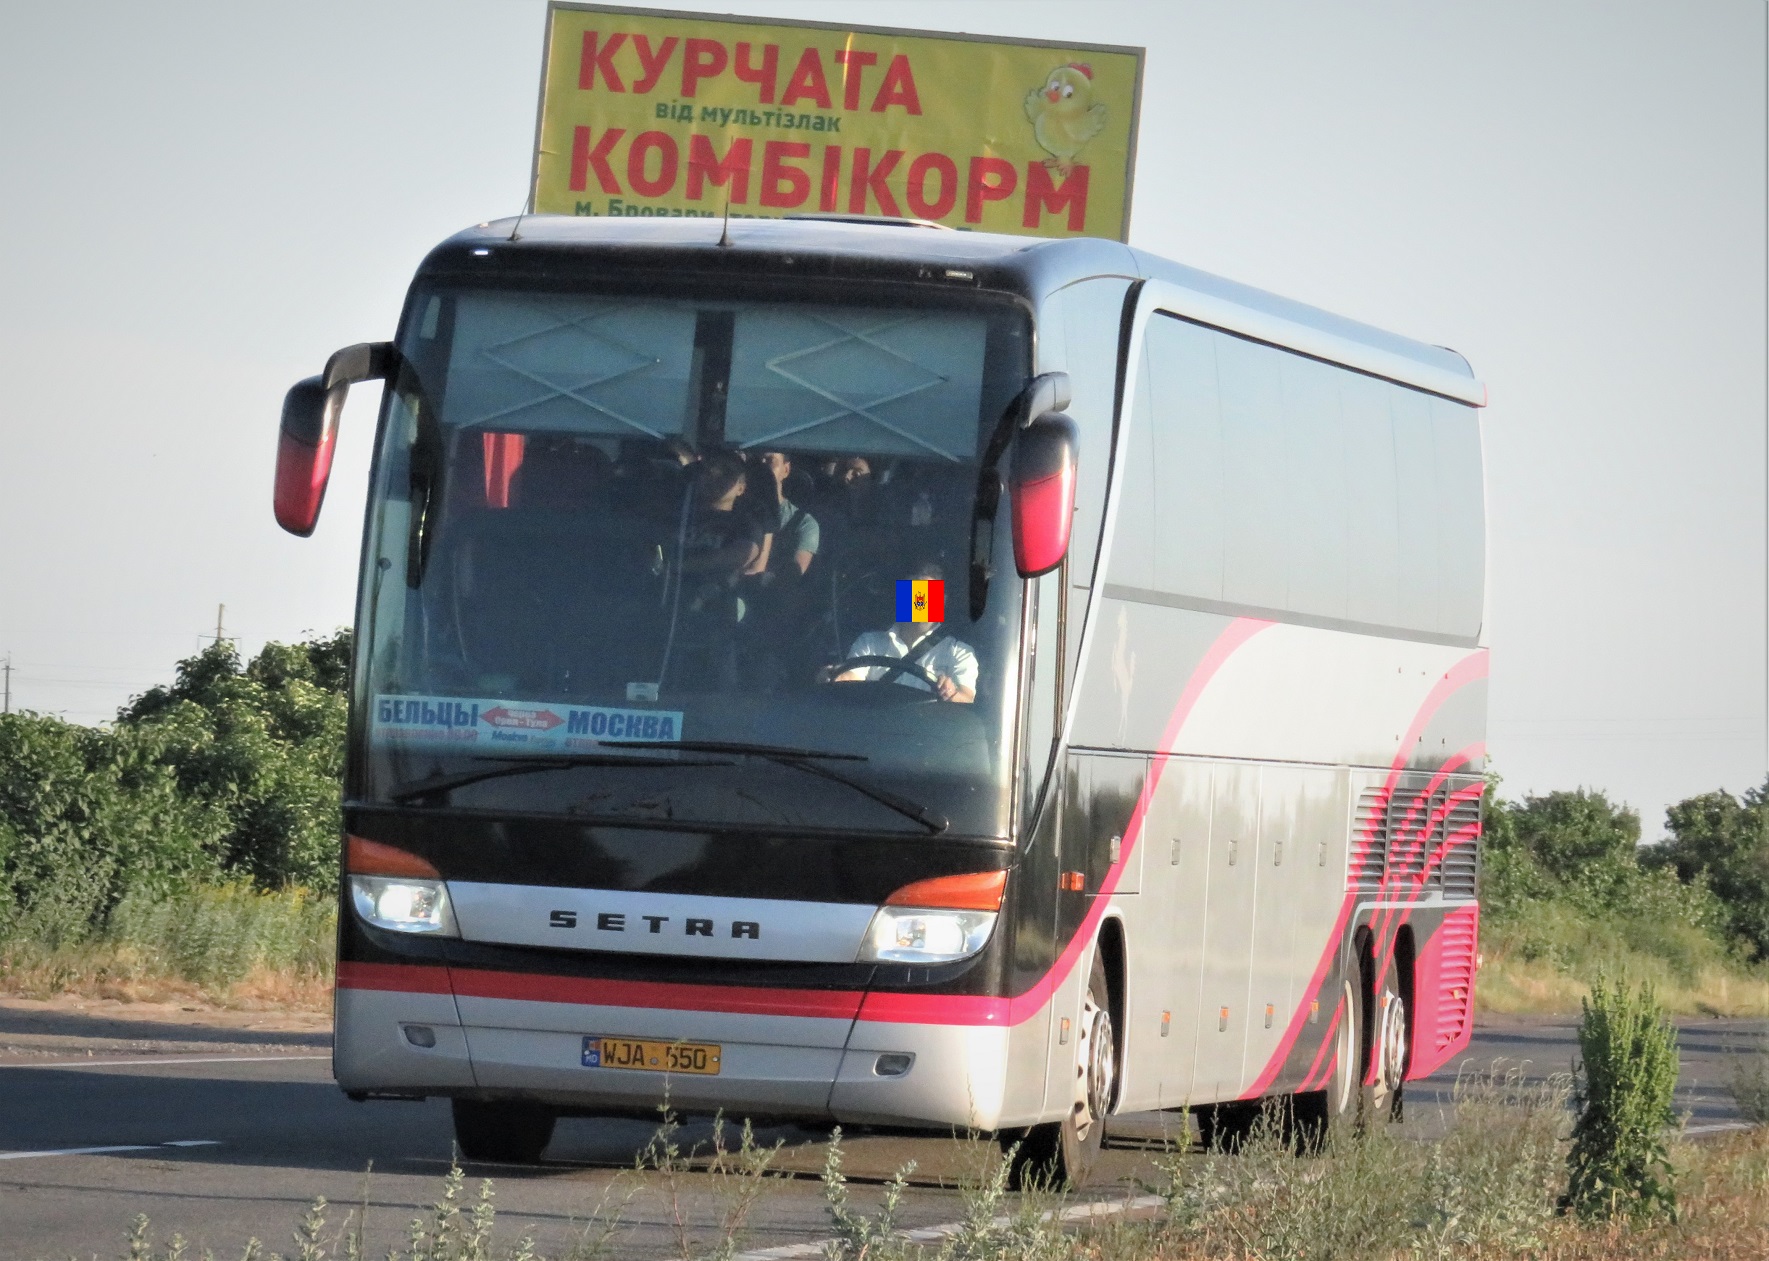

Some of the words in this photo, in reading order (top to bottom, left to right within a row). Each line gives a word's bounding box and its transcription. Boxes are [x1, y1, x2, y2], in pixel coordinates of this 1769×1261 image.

[577, 29, 923, 116] КУРЧАТА
[655, 99, 694, 123] від
[700, 106, 843, 132] мультізлак
[568, 125, 1091, 233] КОМБІКОРМ
[378, 699, 479, 728] БЕЛЬЦЫ
[567, 710, 674, 740] МОСКВА
[549, 910, 760, 940] SETRA
[585, 1053, 598, 1064] MD
[603, 1042, 645, 1067] WJA
[666, 1046, 707, 1071] 550
